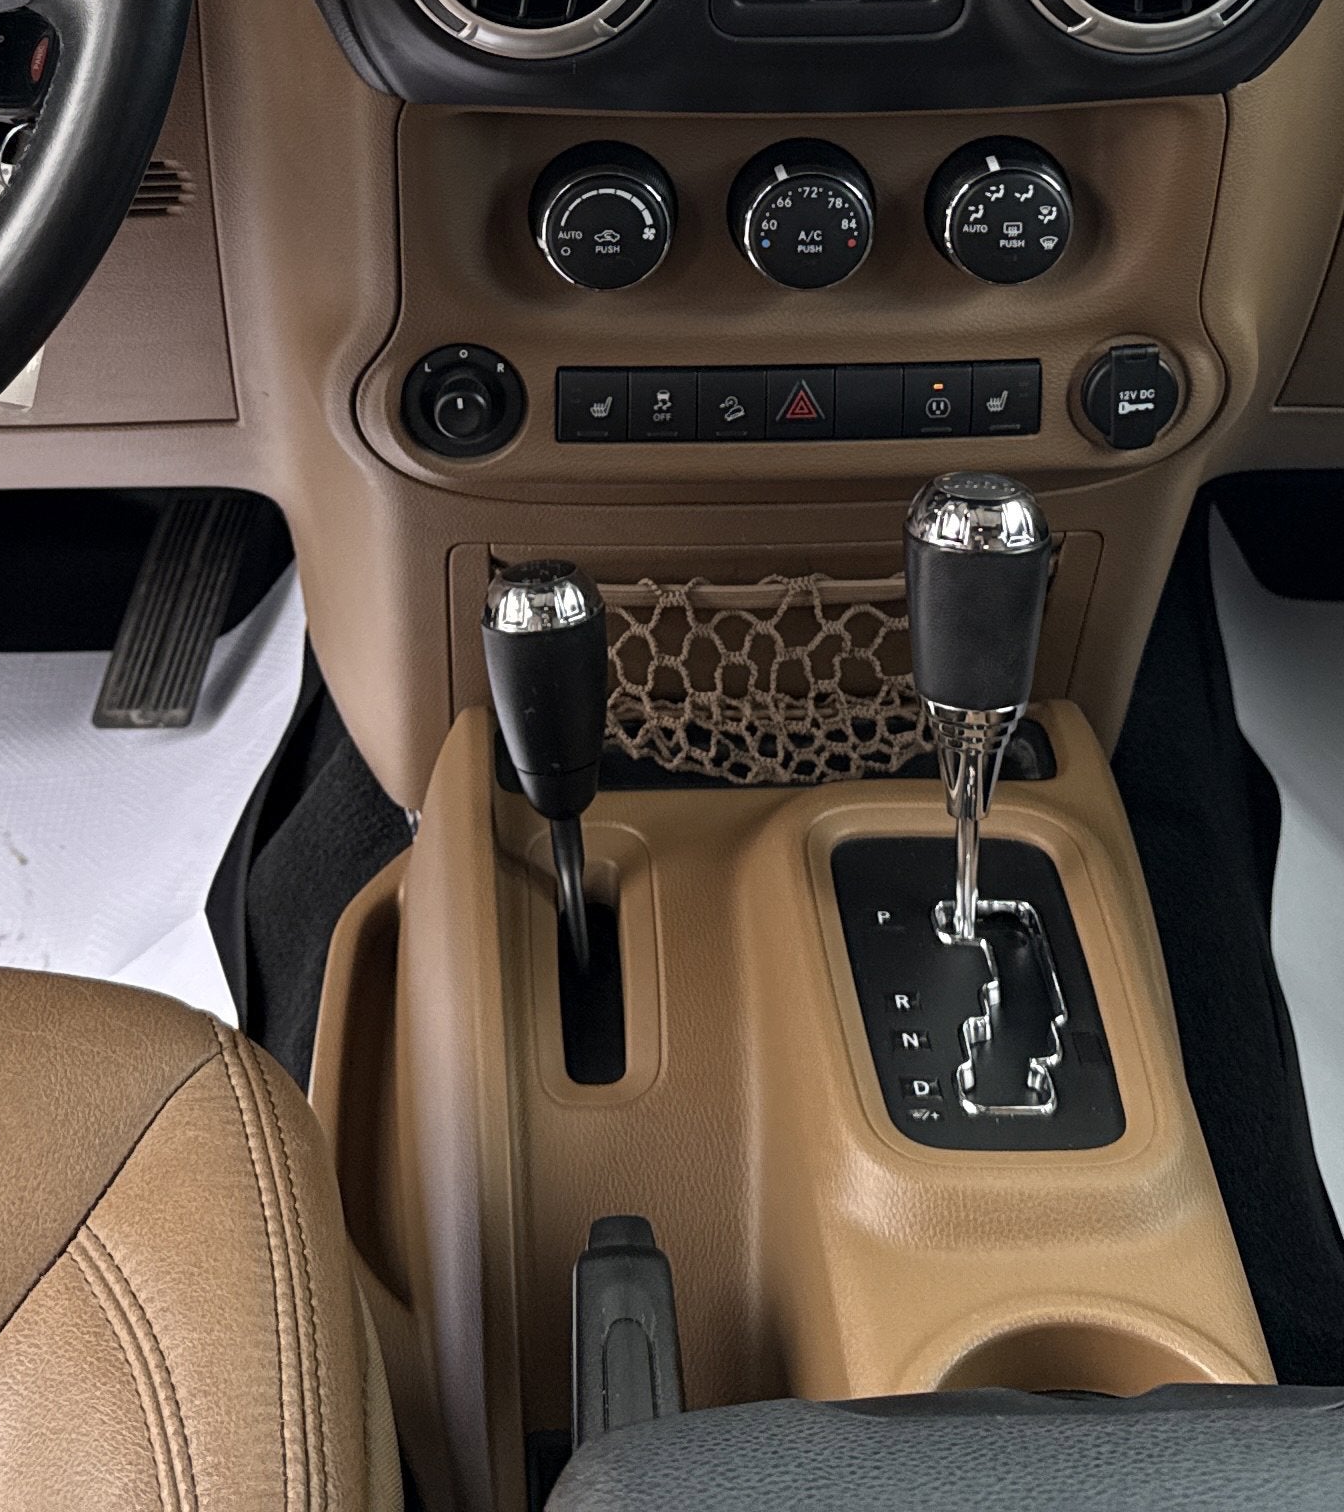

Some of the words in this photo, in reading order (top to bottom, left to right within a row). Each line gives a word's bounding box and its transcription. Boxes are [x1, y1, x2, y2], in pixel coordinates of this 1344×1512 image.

[803, 187, 818, 198] 72
[777, 197, 792, 207] 66
[828, 197, 843, 209] 78
[761, 219, 777, 230] 60
[841, 219, 857, 230] 84
[962, 224, 988, 233] AUTO
[558, 230, 583, 239] AUTO
[798, 230, 822, 242] A/C
[797, 245, 822, 253] PUSH
[1000, 239, 1025, 248] PUSH
[595, 245, 620, 254] PUSH
[424, 362, 432, 372] L
[497, 362, 505, 373] R
[1119, 390, 1138, 401] 12V
[1139, 389, 1155, 400] DC
[653, 412, 671, 422] OFF
[877, 910, 891, 925] P
[894, 994, 911, 1009] R
[902, 1032, 920, 1048] N
[913, 1080, 930, 1096] D
